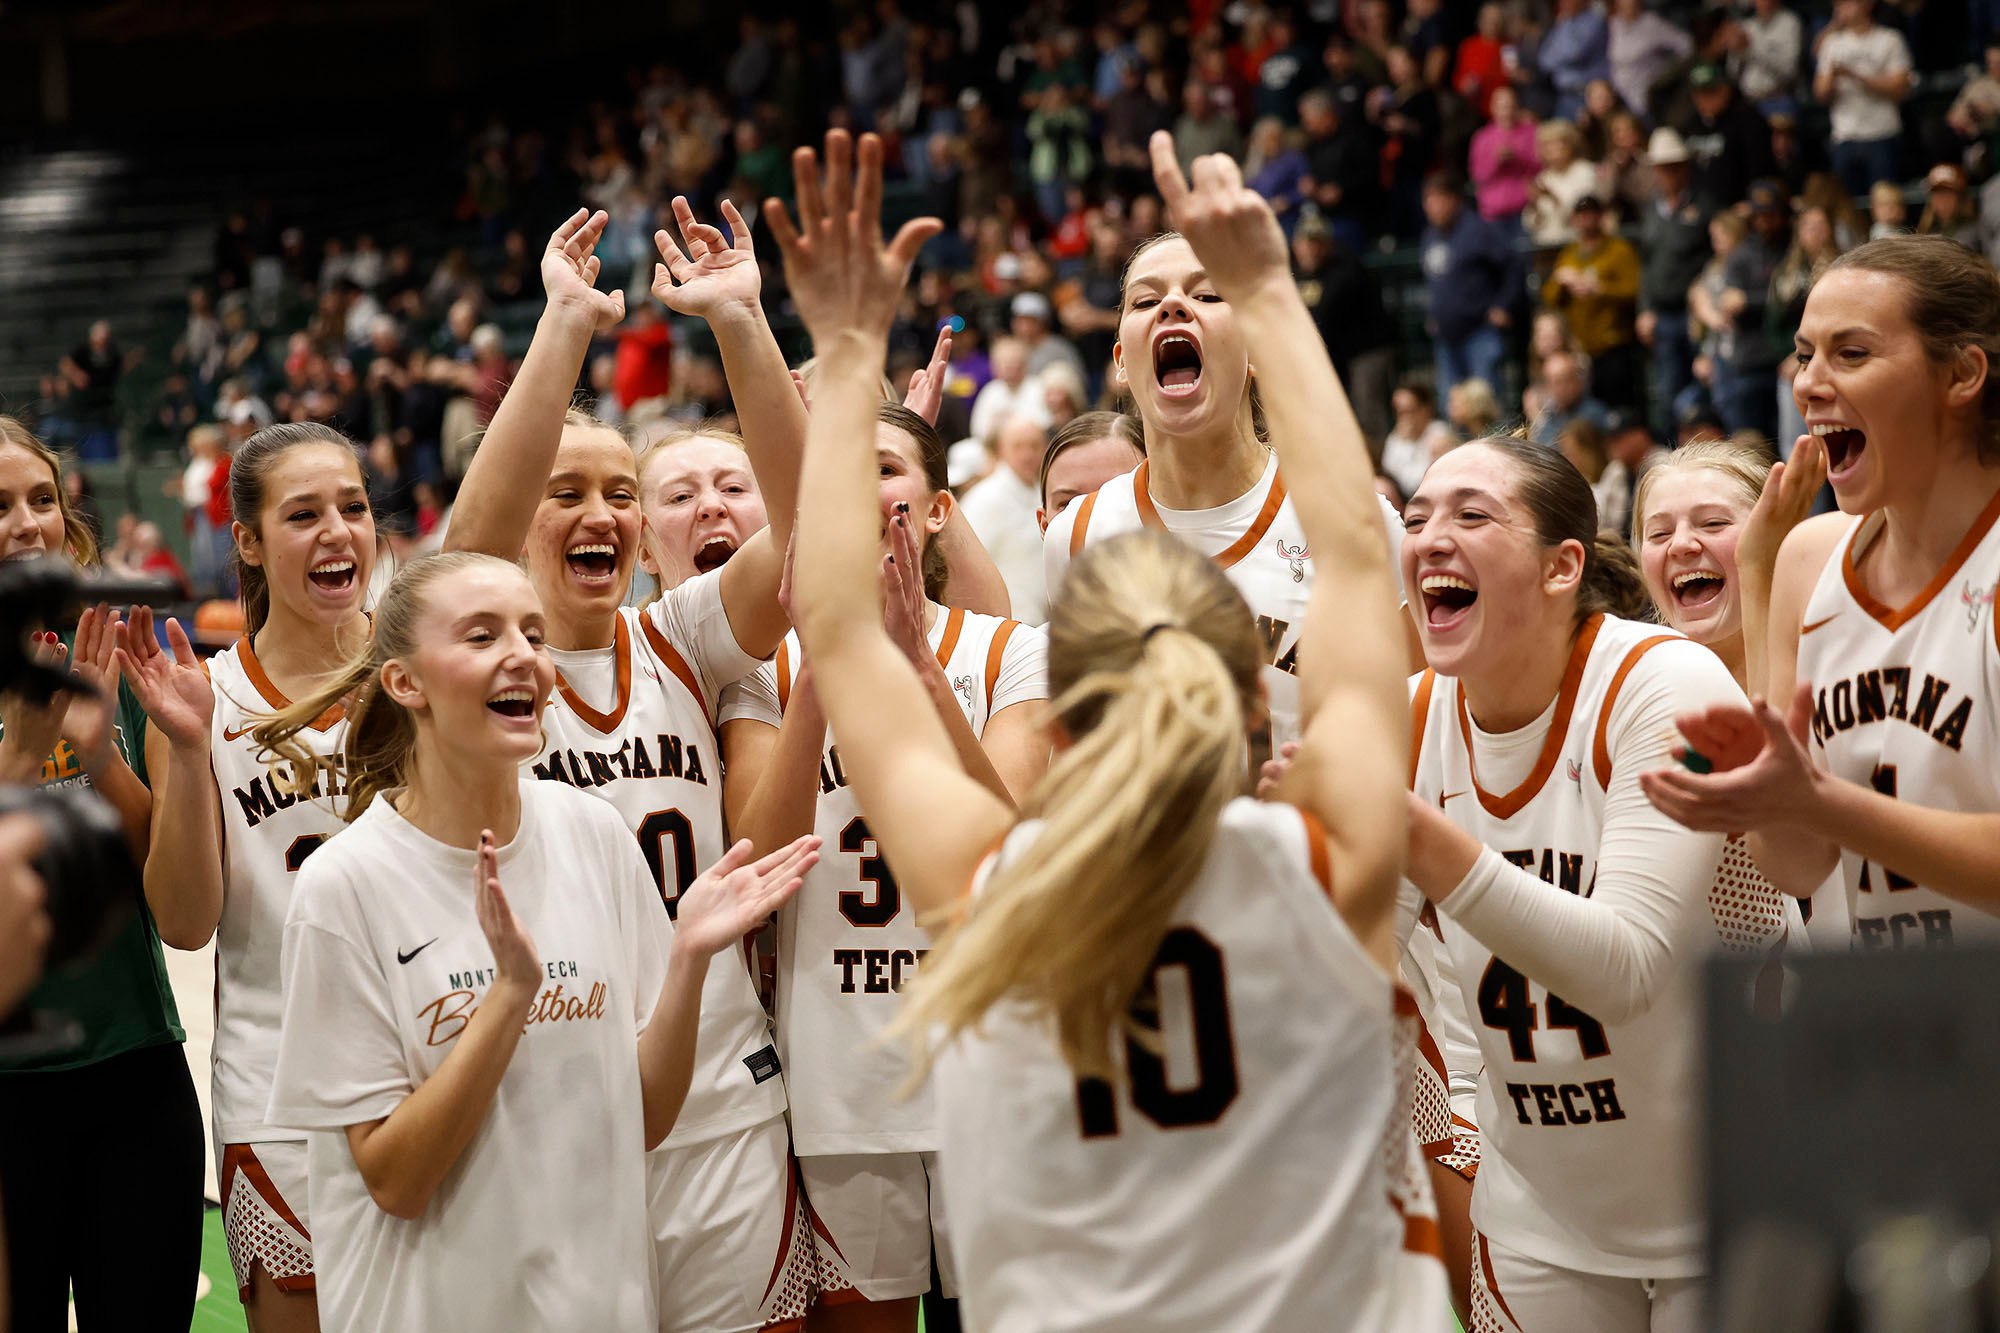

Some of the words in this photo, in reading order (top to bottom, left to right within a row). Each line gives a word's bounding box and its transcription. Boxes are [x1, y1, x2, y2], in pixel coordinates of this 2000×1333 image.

[839, 816, 902, 928] 3
[1851, 908, 1954, 953] ECH
[540, 960, 579, 979] ECH
[833, 949, 931, 994] TEC
[1506, 1078, 1626, 1126] TECH
